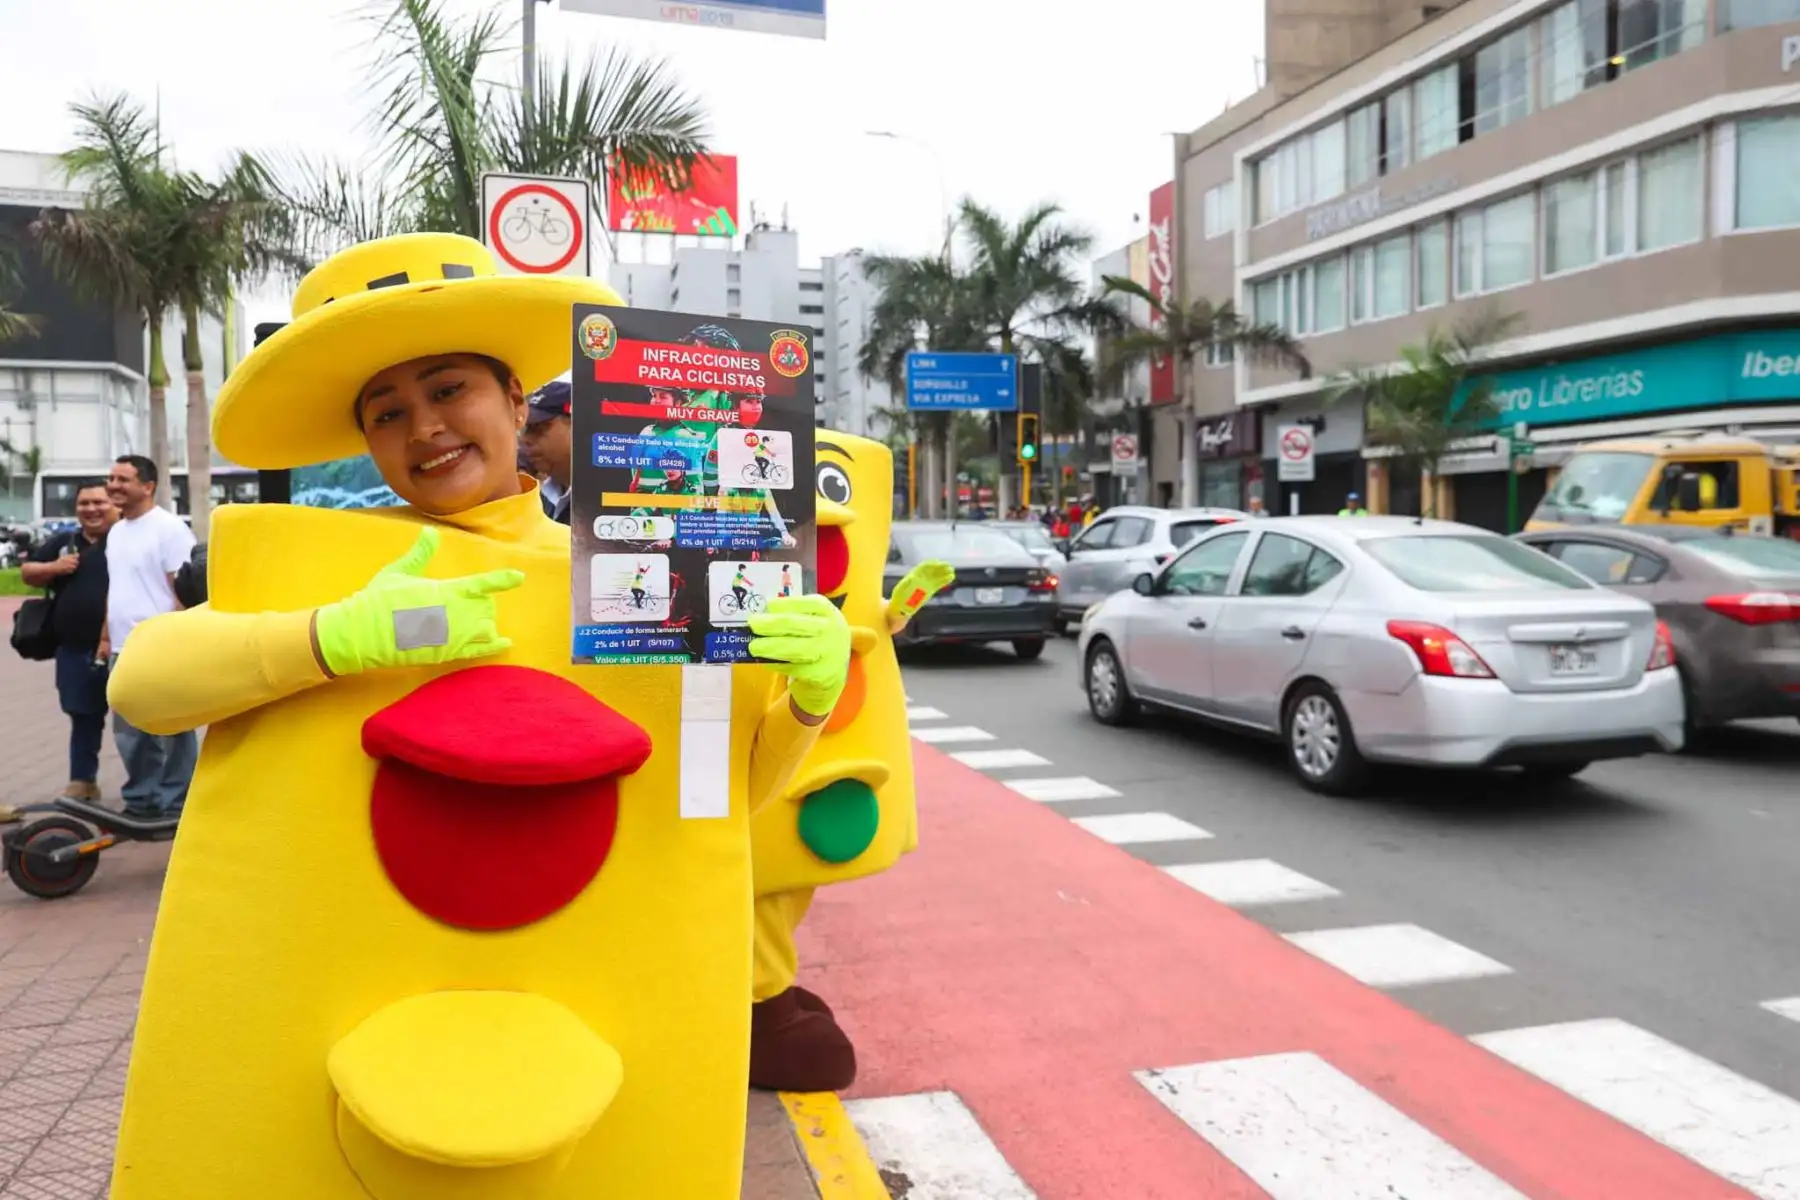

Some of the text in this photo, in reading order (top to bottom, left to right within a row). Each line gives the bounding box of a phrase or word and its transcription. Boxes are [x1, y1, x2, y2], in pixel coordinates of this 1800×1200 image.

[643, 347, 761, 371] INFRACCIONES
[638, 365, 766, 389] PARA CICLISTAS
[666, 407, 740, 422] MUY GRAVE
[598, 455, 612, 464] 8%
[614, 456, 626, 465] de
[628, 457, 633, 465] 1
[636, 457, 651, 466] UIT
[689, 497, 720, 508] LEVE
[694, 538, 704, 546] de
[592, 627, 624, 635] Conducir
[609, 640, 619, 648] de
[621, 640, 625, 648] 1
[627, 639, 641, 648] UIT
[736, 649, 747, 658] de
[594, 656, 618, 664] Valor
[620, 656, 632, 664] de
[633, 655, 648, 664] UIT
